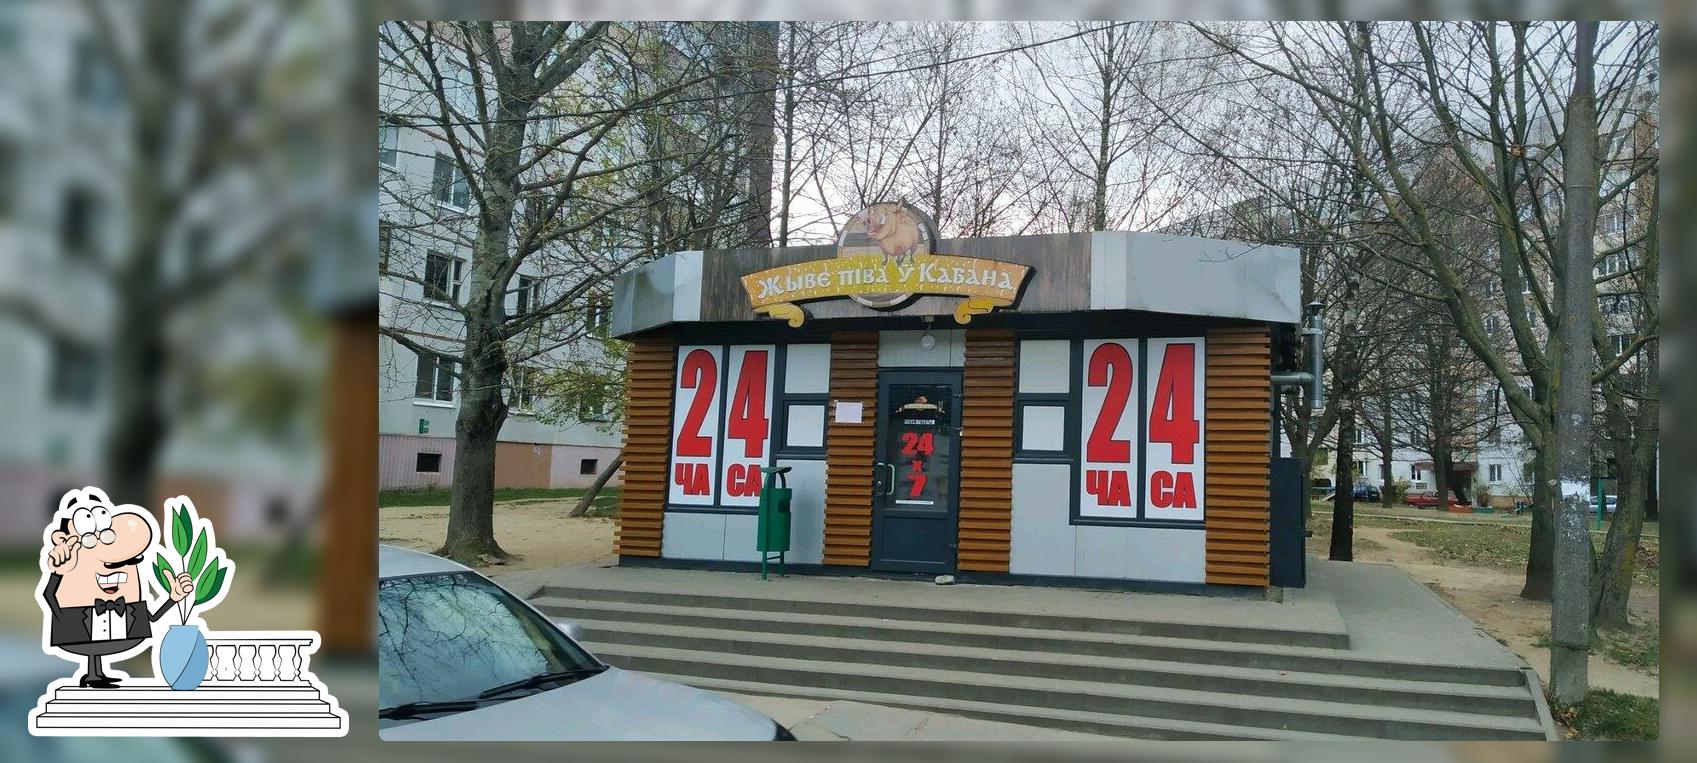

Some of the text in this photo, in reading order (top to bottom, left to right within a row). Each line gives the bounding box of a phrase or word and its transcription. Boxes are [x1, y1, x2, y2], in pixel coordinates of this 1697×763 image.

[676, 348, 769, 458] 24
[1087, 342, 1200, 464] 24
[902, 431, 934, 456] 24
[907, 472, 928, 497] 7
